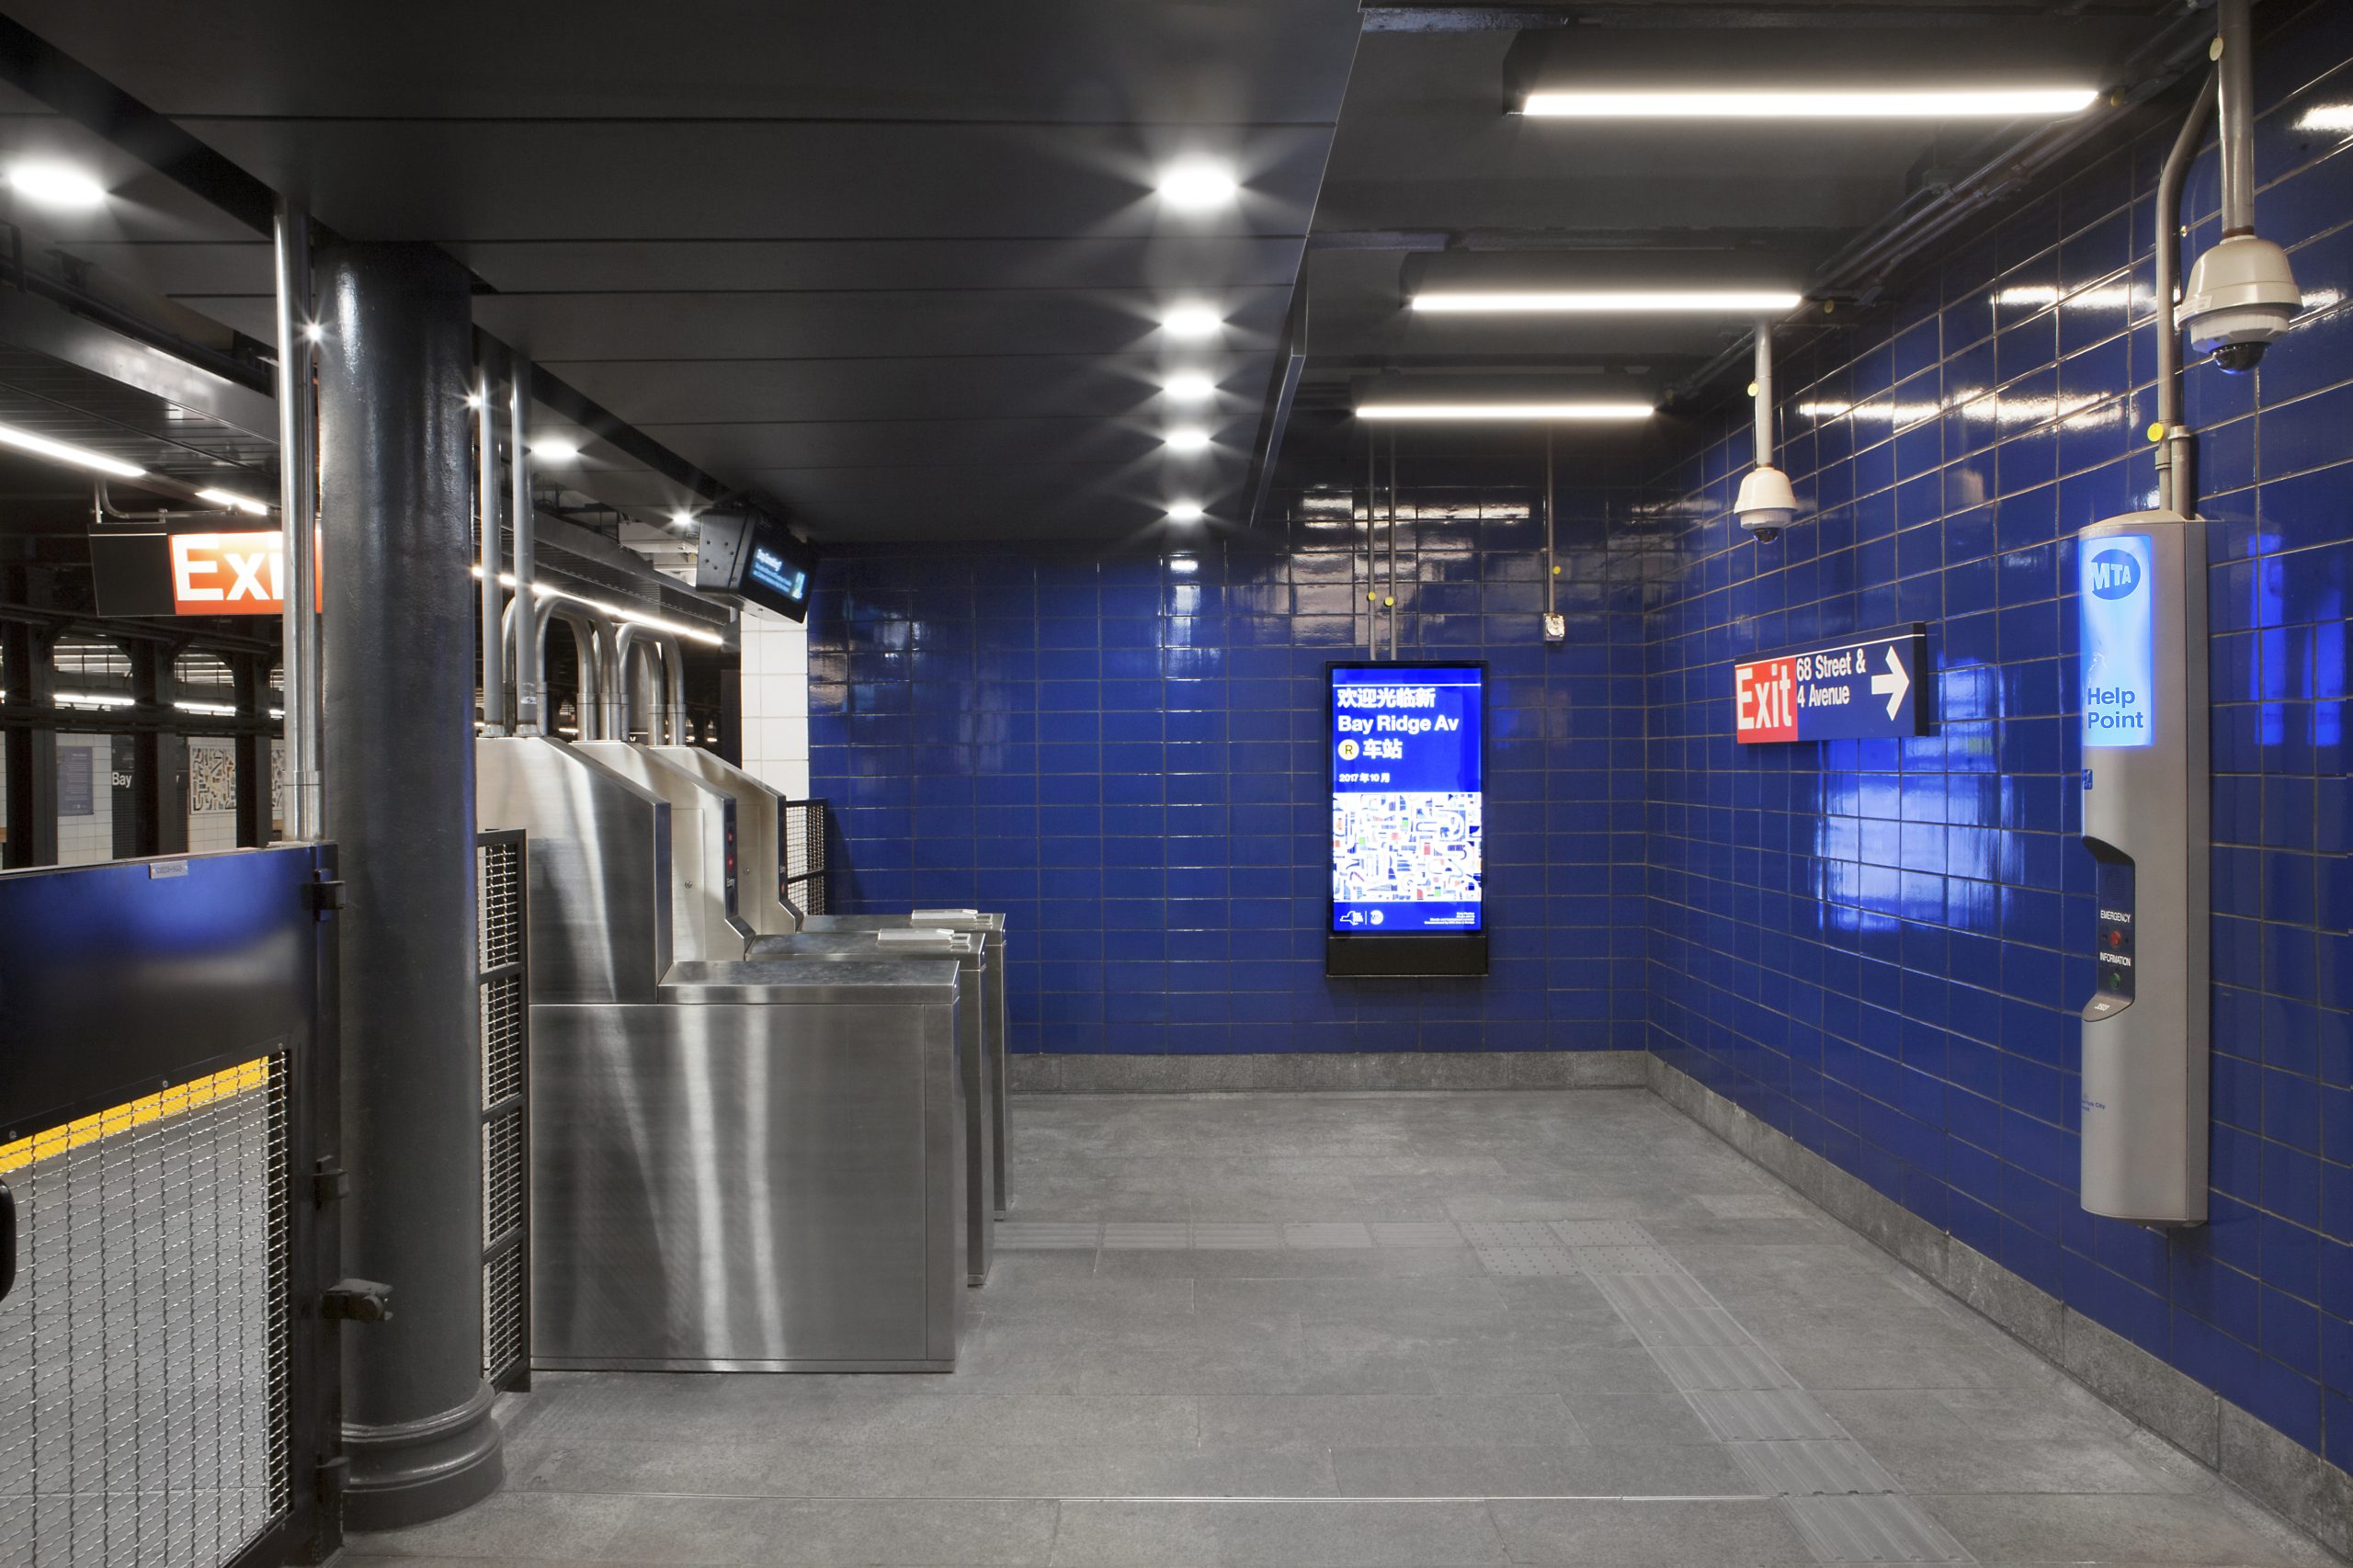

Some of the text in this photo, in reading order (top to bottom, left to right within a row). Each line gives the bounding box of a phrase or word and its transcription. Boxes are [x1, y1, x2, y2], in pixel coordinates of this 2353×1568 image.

[172, 533, 284, 600] Exi
[2090, 562, 2131, 590] MTA
[1736, 648, 1866, 730] Exit 68 Street &
[1797, 684, 1850, 708] 4 Avenue
[2087, 687, 2135, 708] Help
[1337, 714, 1460, 734] Bay Ridge Av
[2087, 711, 2143, 729] Point
[1362, 738, 1403, 759] 车站
[112, 772, 132, 788] Bay
[2100, 910, 2131, 923] EMERGENCY
[2099, 951, 2131, 966] INFORMATION
